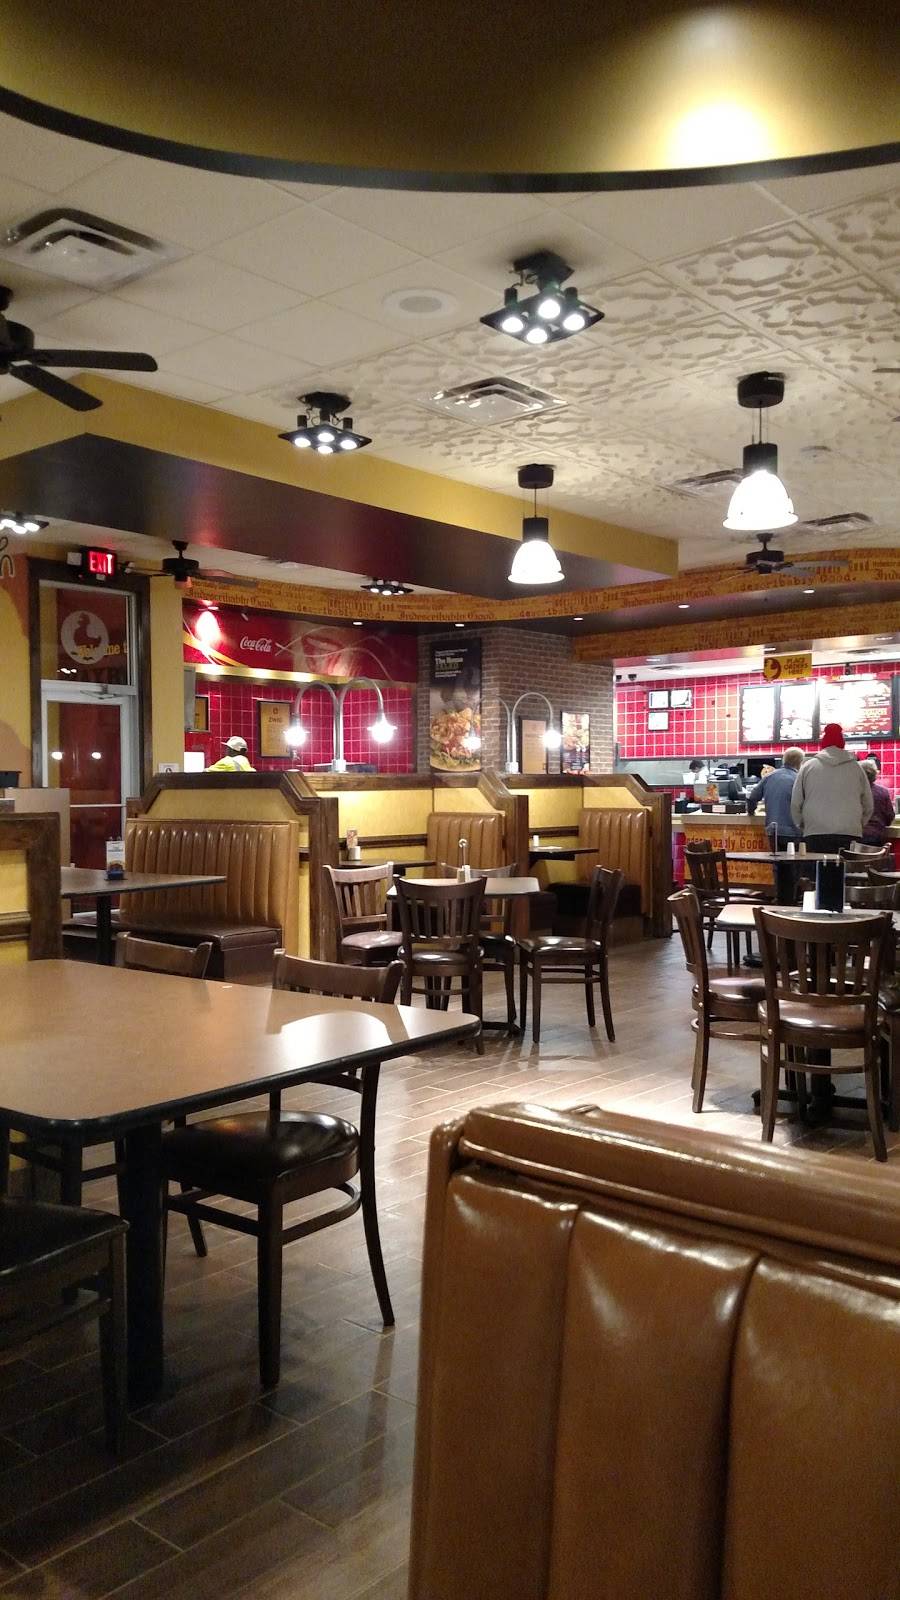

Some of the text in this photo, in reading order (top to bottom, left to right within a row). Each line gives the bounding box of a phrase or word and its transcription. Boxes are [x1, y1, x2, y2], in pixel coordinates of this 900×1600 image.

[89, 551, 113, 575] EXIT
[786, 657, 805, 665] PLACE
[784, 662, 808, 671] ORDERS
